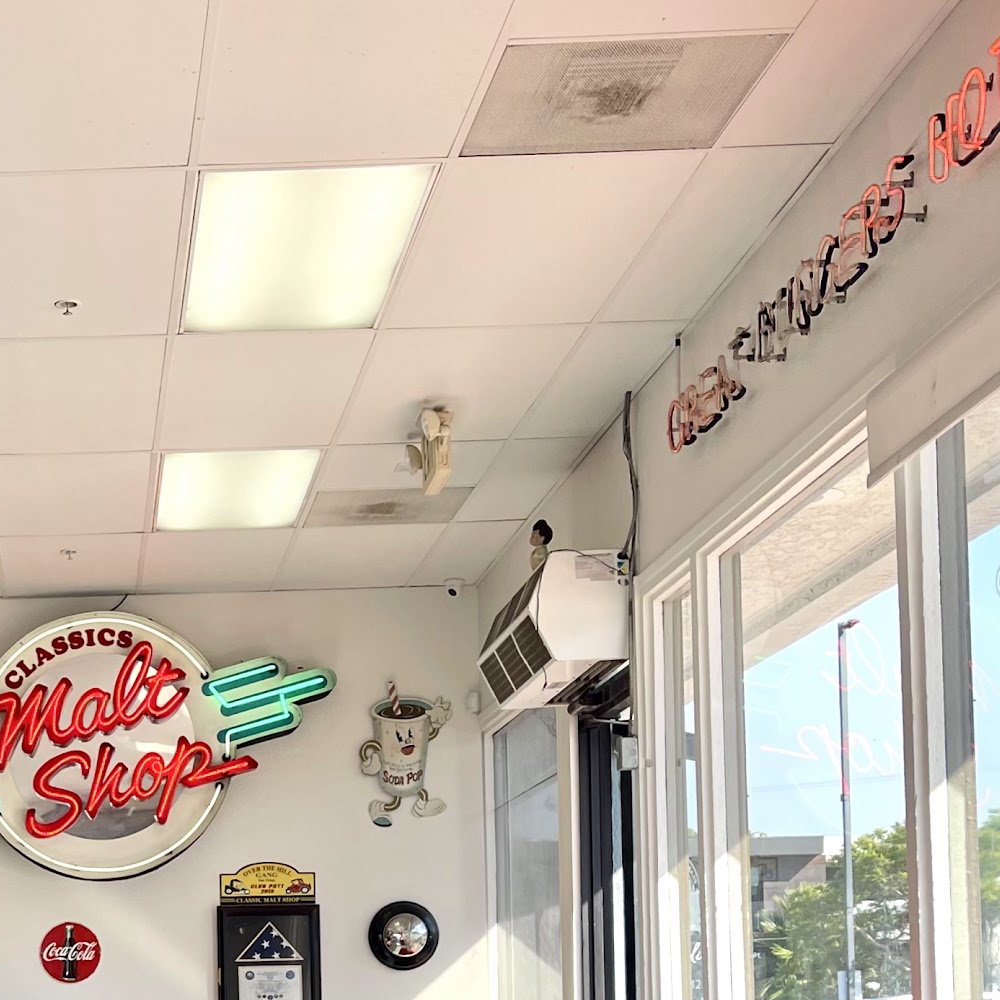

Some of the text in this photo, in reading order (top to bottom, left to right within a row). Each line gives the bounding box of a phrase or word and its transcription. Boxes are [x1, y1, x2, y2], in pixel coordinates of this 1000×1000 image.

[4, 627, 133, 689] CLASSICS
[25, 736, 259, 838] Shop
[382, 770, 423, 785] SODA POP
[243, 866, 261, 877] OVER
[276, 866, 292, 876] HILL
